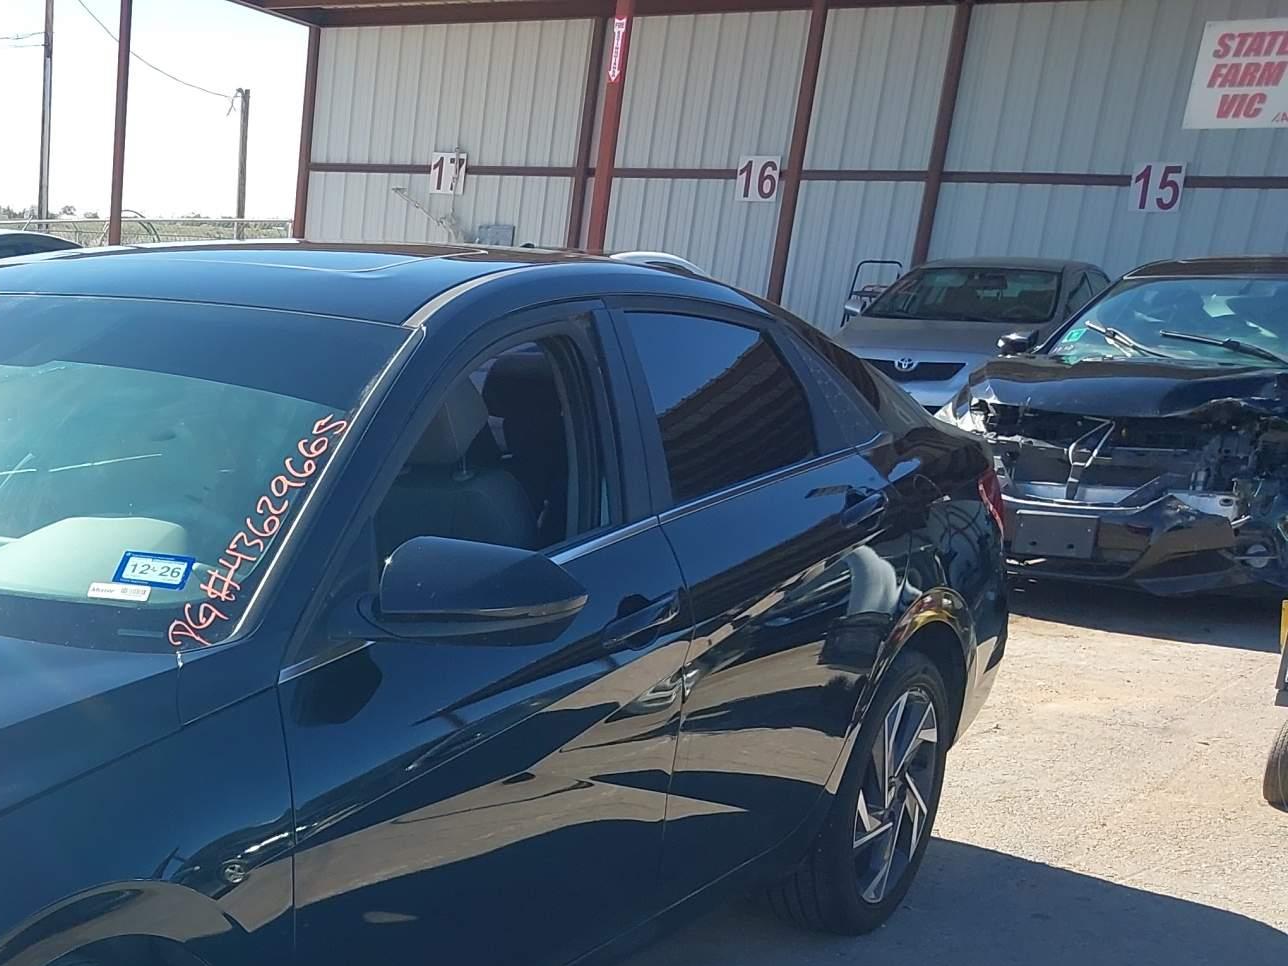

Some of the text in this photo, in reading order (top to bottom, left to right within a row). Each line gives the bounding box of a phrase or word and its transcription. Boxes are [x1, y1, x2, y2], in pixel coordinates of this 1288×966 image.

[1206, 61, 1288, 88] FARM
[1216, 93, 1267, 119] VIC
[739, 160, 777, 199] 16
[1134, 165, 1183, 210] 15
